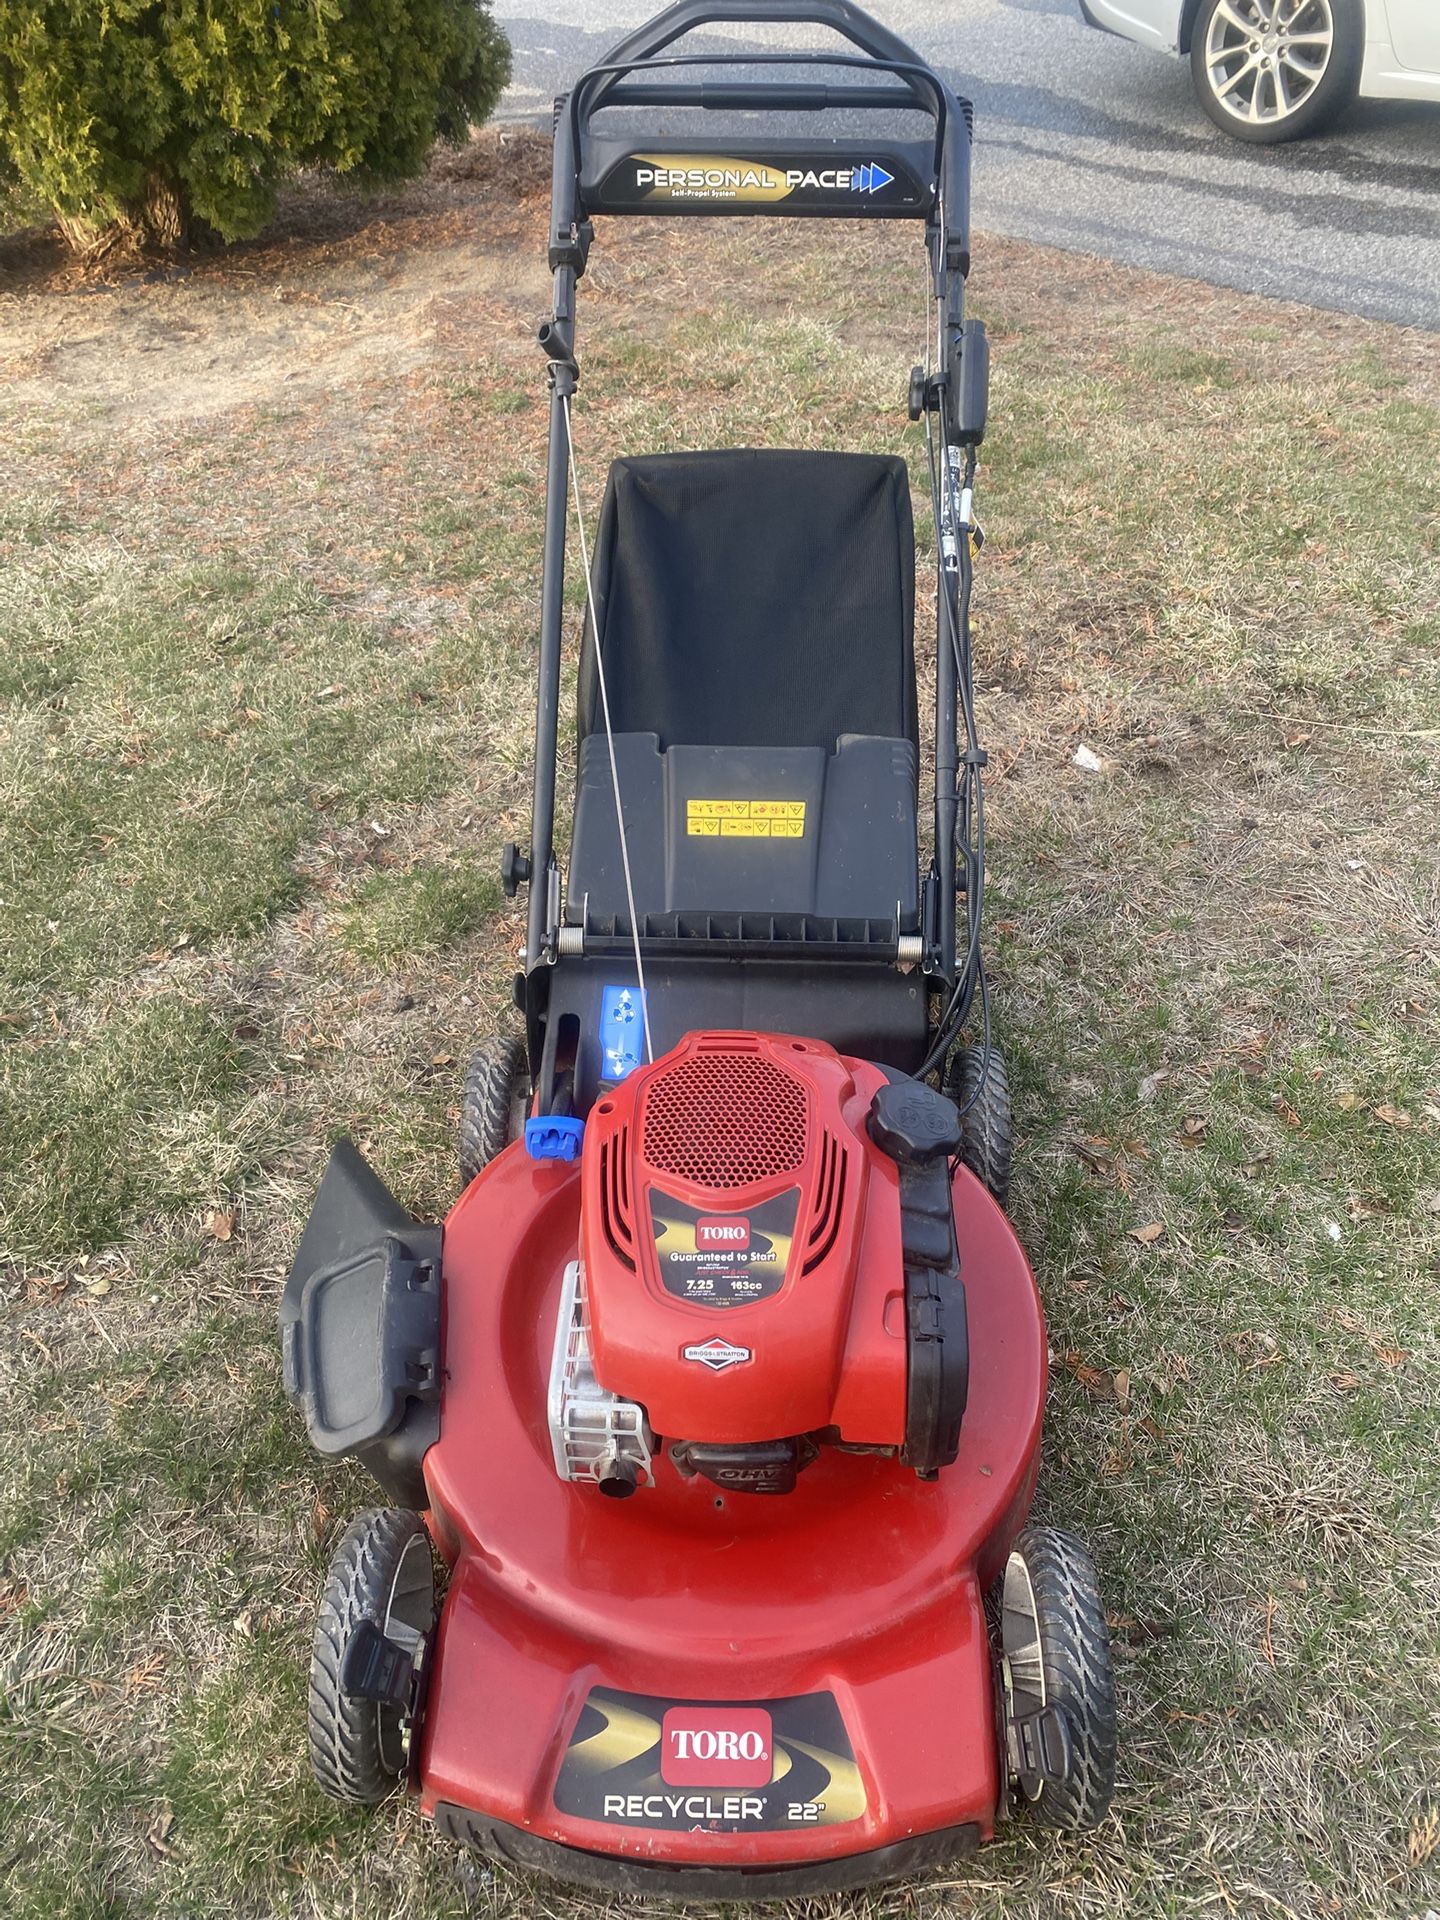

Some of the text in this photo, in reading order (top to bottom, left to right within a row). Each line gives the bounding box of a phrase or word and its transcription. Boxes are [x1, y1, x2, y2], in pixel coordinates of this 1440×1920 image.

[636, 169, 850, 188] PERSONAL PACE
[671, 188, 736, 198] Self-Propel System
[701, 1226, 746, 1240] TORO
[670, 1252, 777, 1262] Guaranteed to Start
[686, 1279, 763, 1290] 7.25 163cc
[671, 1730, 764, 1760] TORO
[603, 1795, 763, 1820] RECYCLER
